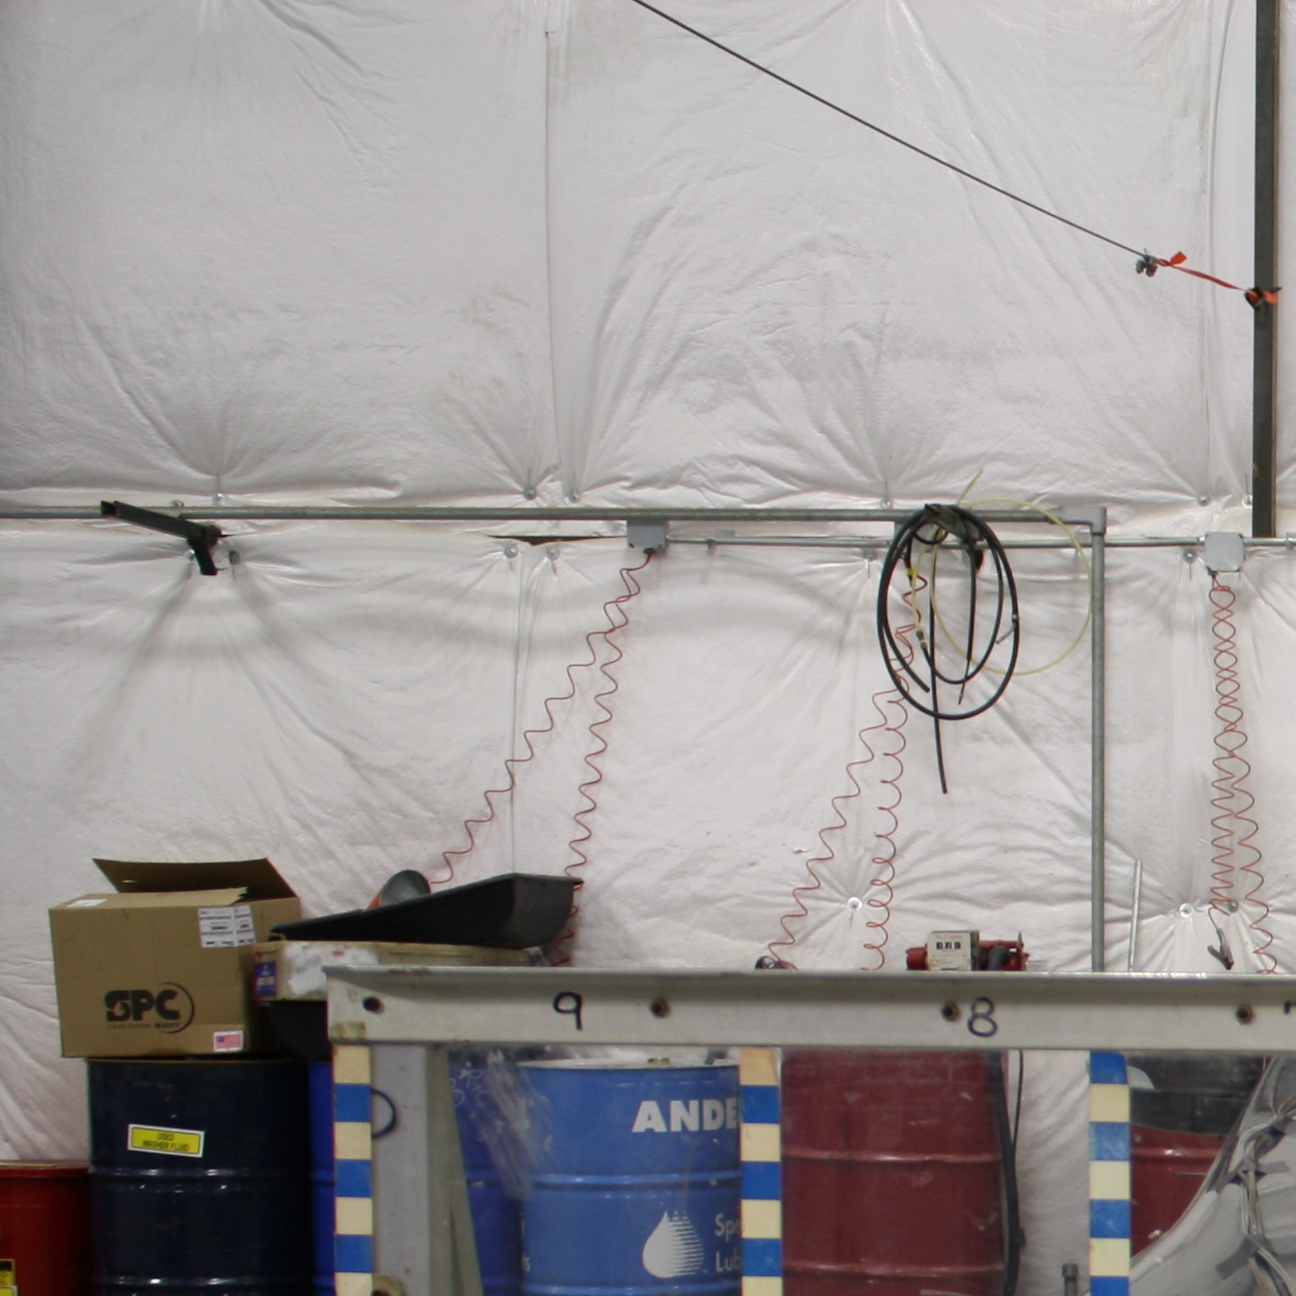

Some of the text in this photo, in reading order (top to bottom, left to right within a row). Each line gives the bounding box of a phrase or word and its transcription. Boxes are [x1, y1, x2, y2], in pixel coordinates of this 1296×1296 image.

[104, 989, 181, 1022] SPC
[553, 992, 583, 1031] 9
[967, 997, 997, 1036] 8
[631, 1098, 739, 1132] ANDE
[715, 1214, 740, 1242] Spe
[715, 1248, 740, 1273] Lub
